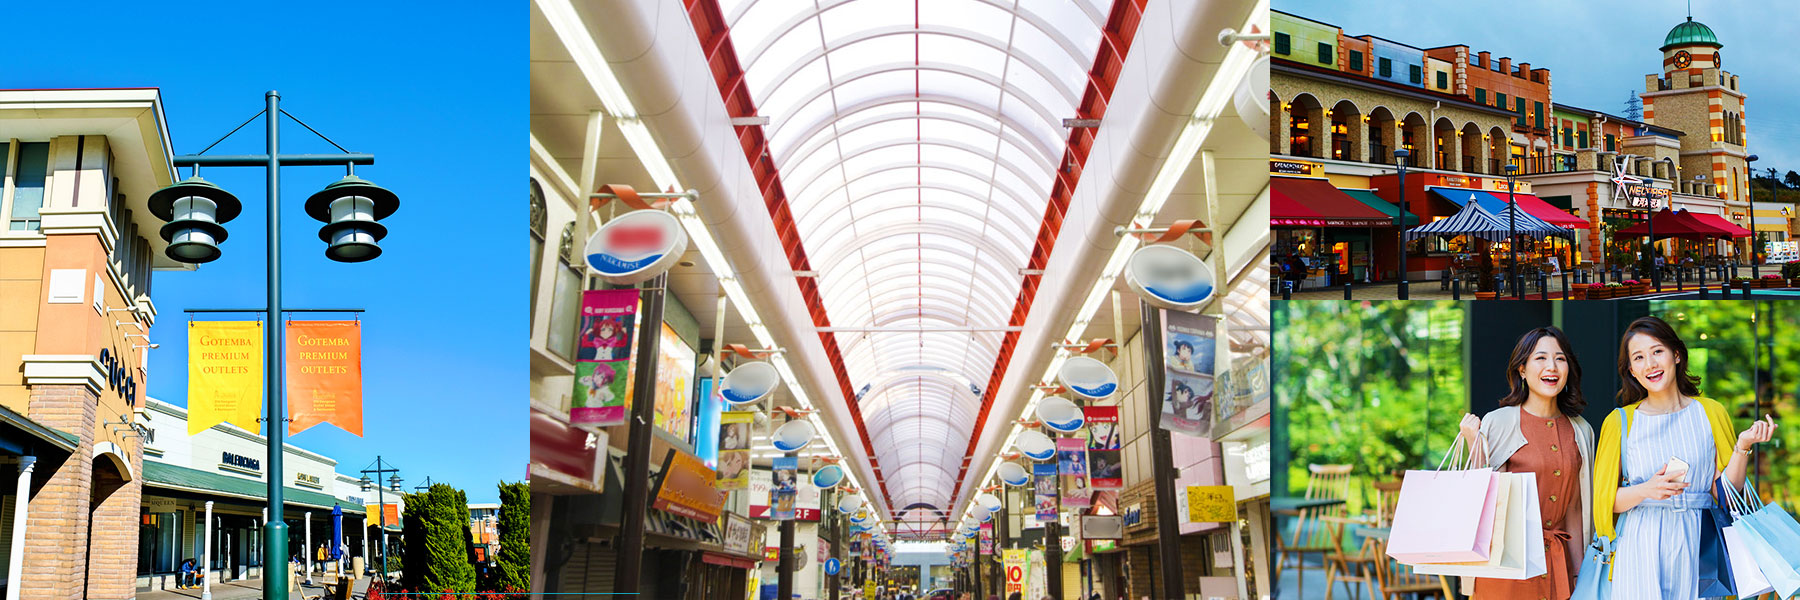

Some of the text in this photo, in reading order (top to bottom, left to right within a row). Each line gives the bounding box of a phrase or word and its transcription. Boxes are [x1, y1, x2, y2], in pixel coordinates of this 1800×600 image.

[600, 254, 640, 270] NAKAMISE
[200, 335, 252, 346] GOTEMBA
[297, 334, 350, 346] GOTEMBA
[202, 352, 249, 360] PREMIUM
[299, 352, 348, 360] PREMIUM
[203, 366, 249, 374] OUTLETS
[301, 366, 348, 374] OUTLETS
[100, 348, 136, 407] GUCCI
